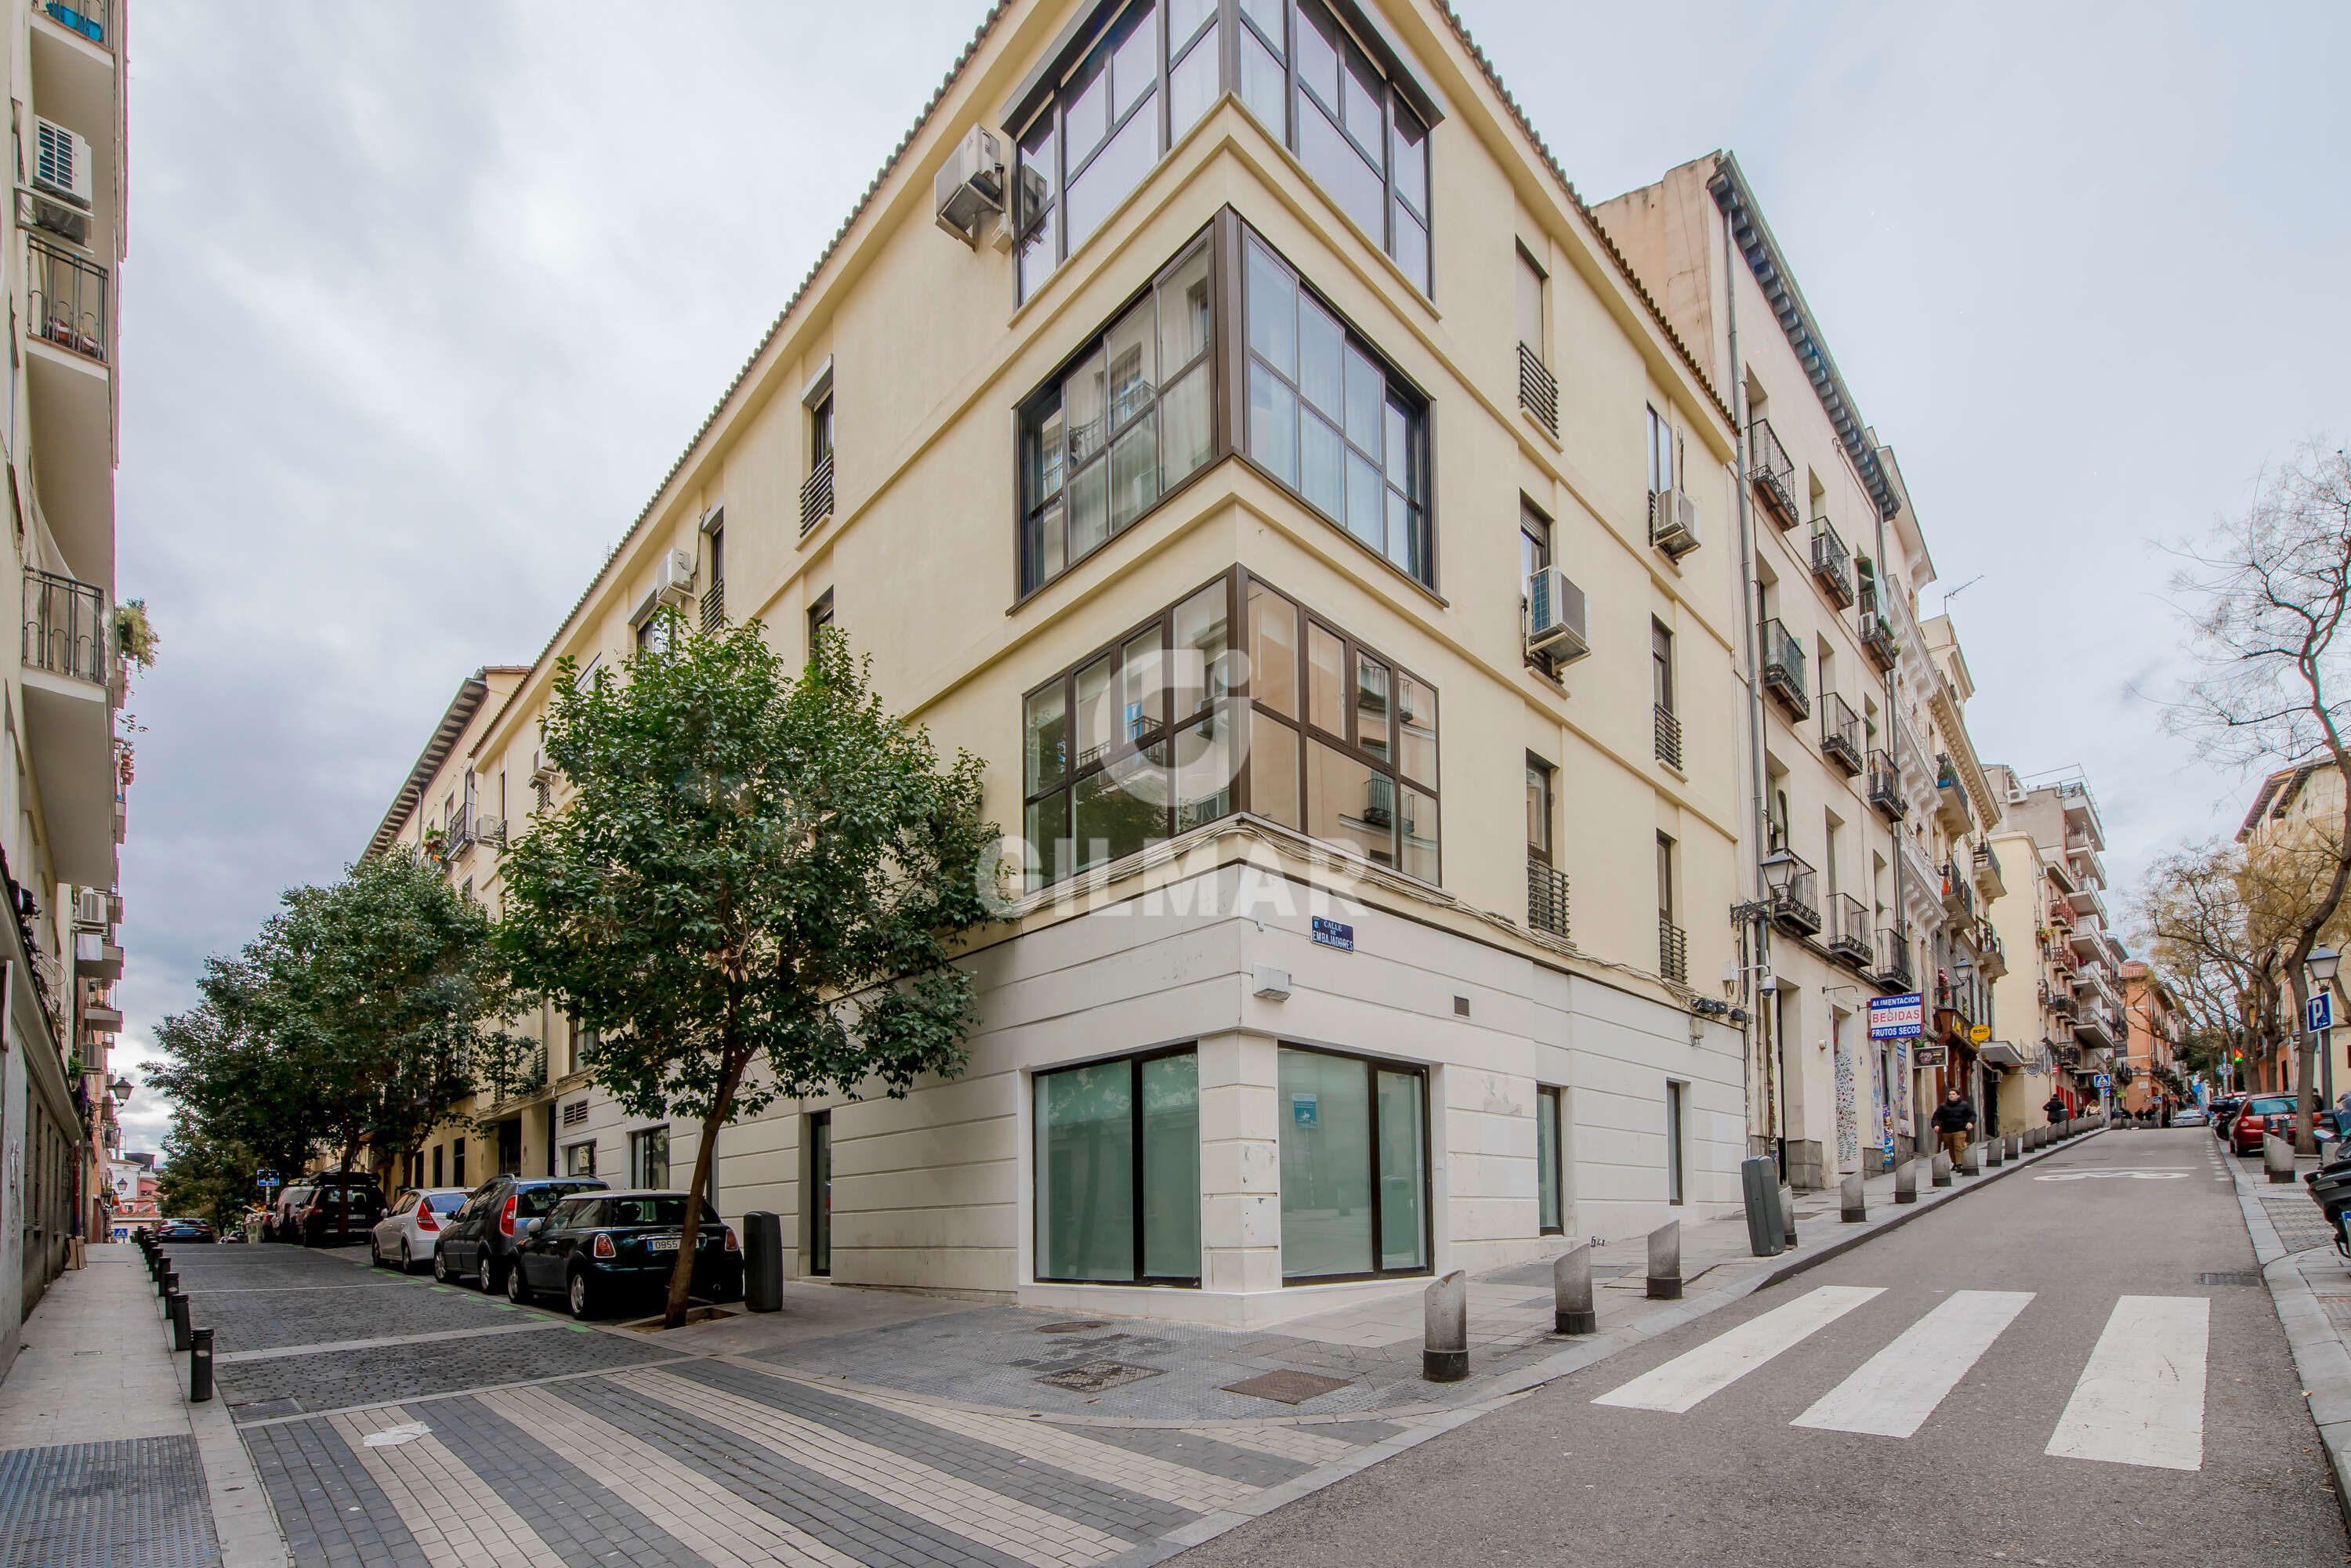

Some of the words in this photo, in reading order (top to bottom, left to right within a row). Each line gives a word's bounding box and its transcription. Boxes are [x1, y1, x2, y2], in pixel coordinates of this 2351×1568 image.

[1324, 921, 1342, 932] CALLE
[1313, 930, 1353, 951] EMBAJADORES
[1872, 996, 1920, 1007] ALIMENTACION
[2312, 998, 2324, 1027] P
[1871, 1027, 1896, 1037] FRUTOS
[1898, 1026, 1921, 1035] SECOS
